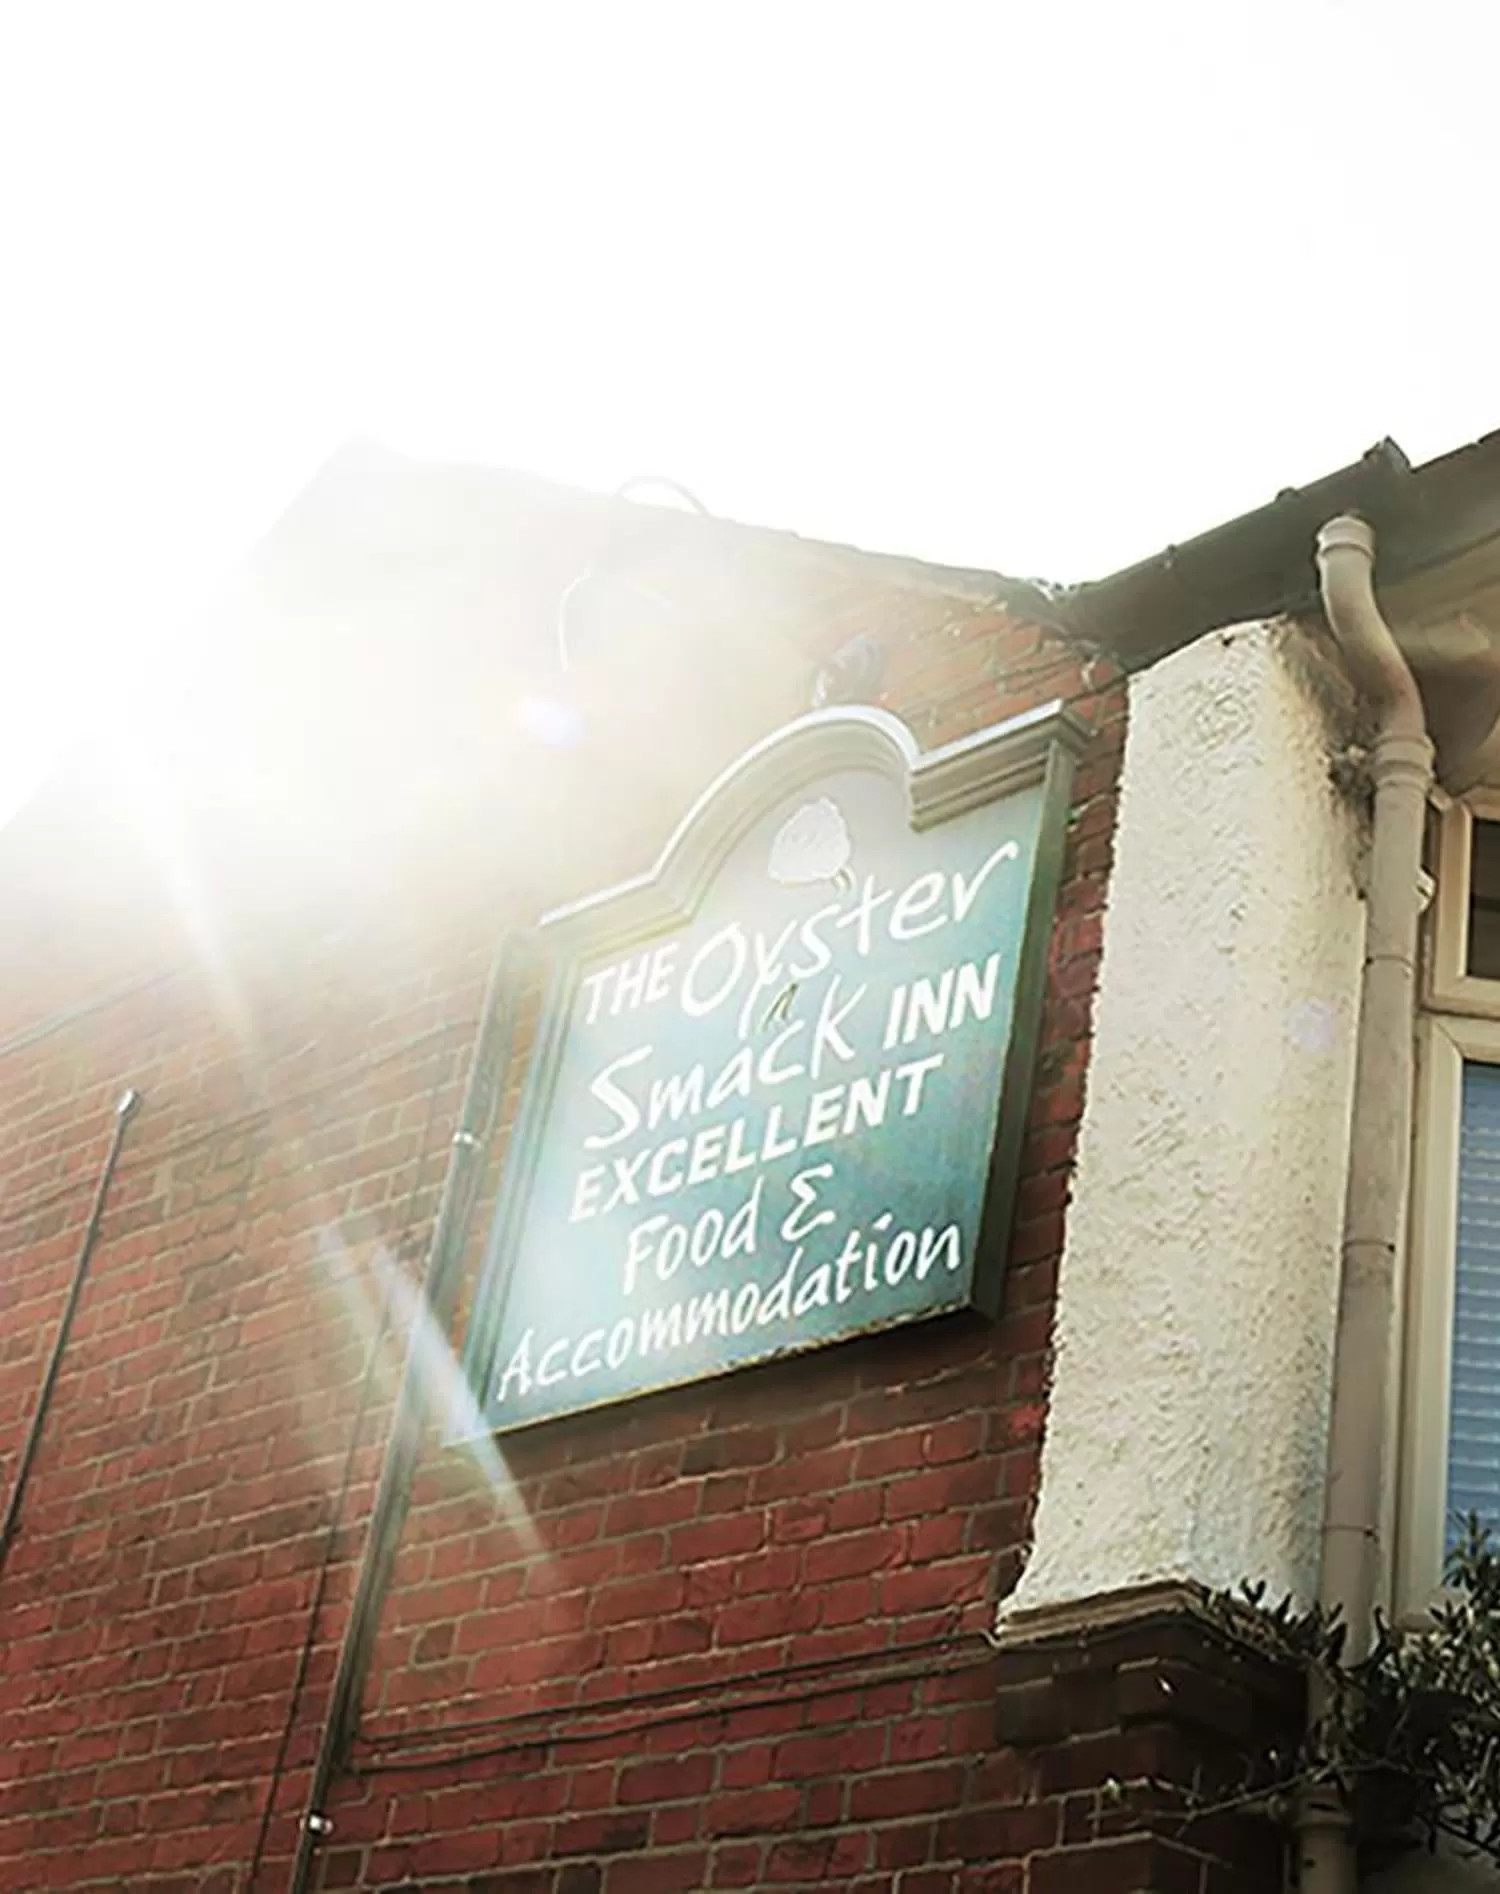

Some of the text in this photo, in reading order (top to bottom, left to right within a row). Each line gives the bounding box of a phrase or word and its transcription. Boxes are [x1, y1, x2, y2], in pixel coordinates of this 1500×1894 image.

[582, 841, 1018, 1039] THE Oyster
[569, 1053, 944, 1222] EXCELLENT
[582, 953, 1001, 1149] Smack INN
[496, 1212, 961, 1402] Accommodation
[622, 1174, 765, 1296] Food
